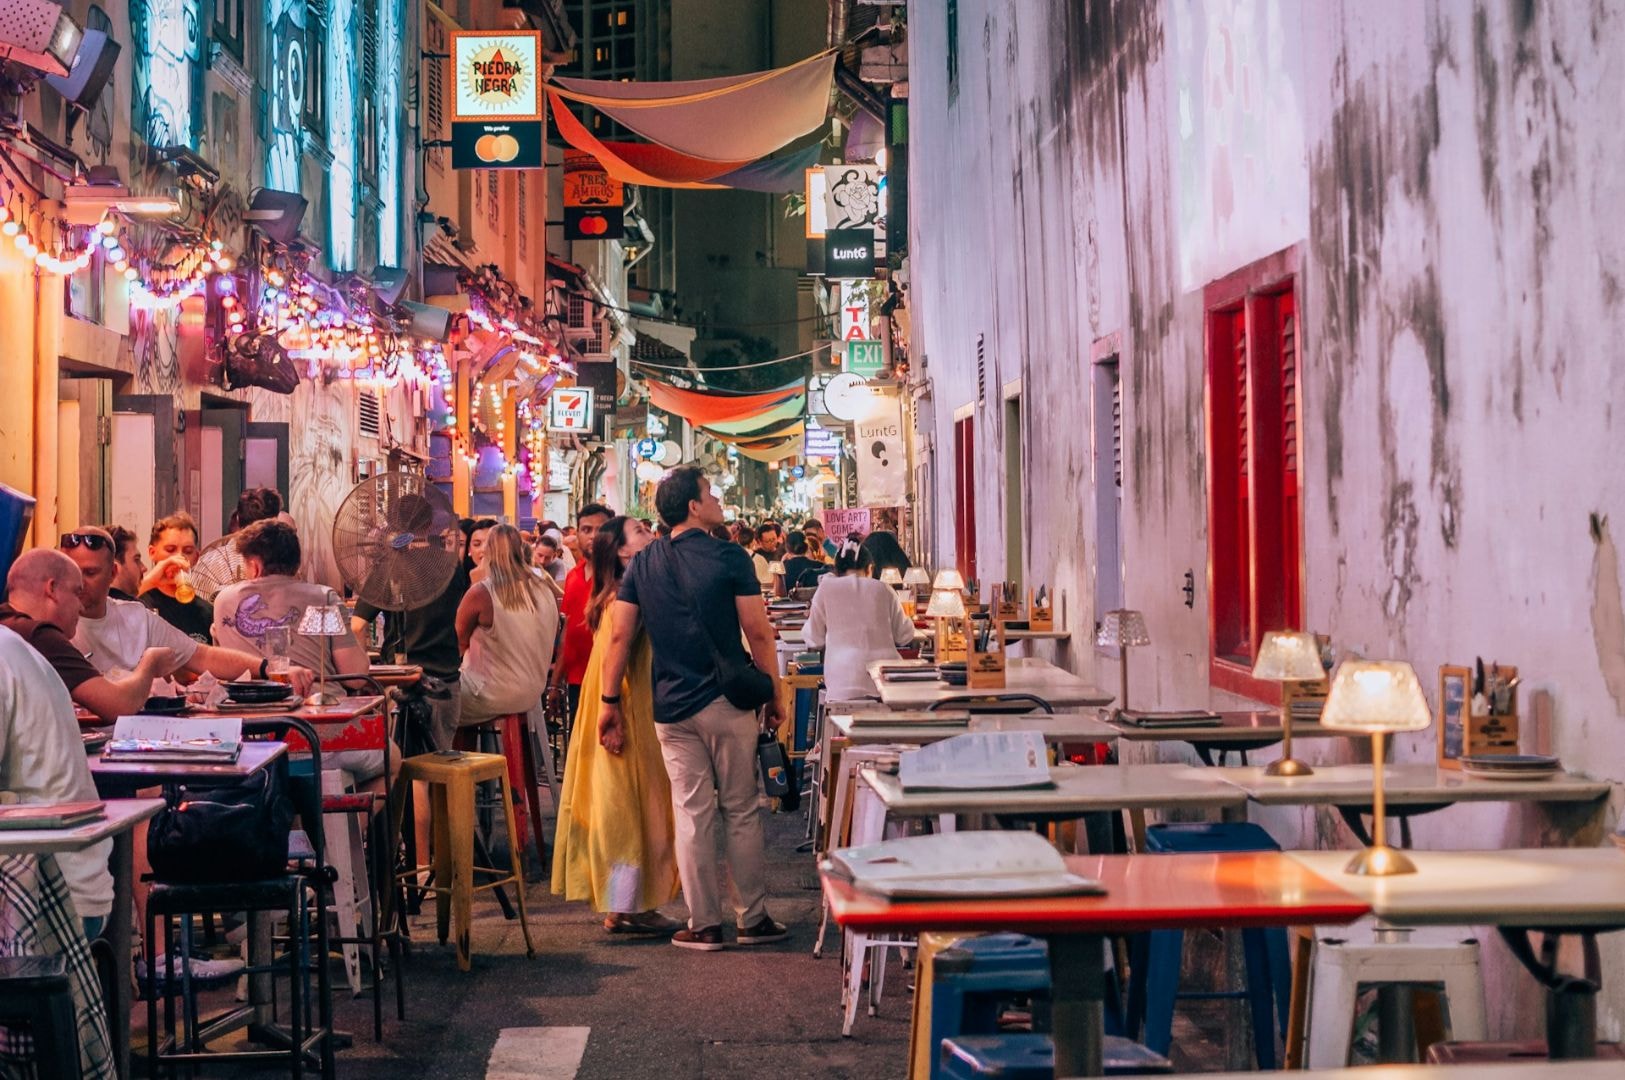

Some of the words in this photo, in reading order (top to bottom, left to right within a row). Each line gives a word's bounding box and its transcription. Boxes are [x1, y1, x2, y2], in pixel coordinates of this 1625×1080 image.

[472, 60, 522, 76] PIEDRA
[475, 78, 518, 93] NEGRA
[579, 173, 608, 186] TRES
[572, 184, 614, 199] AMIGOS
[833, 247, 867, 260] LuntG
[860, 425, 897, 438] LuntG
[826, 512, 846, 523] LOVE
[847, 511, 868, 523] ART?
[831, 523, 854, 535] COME
